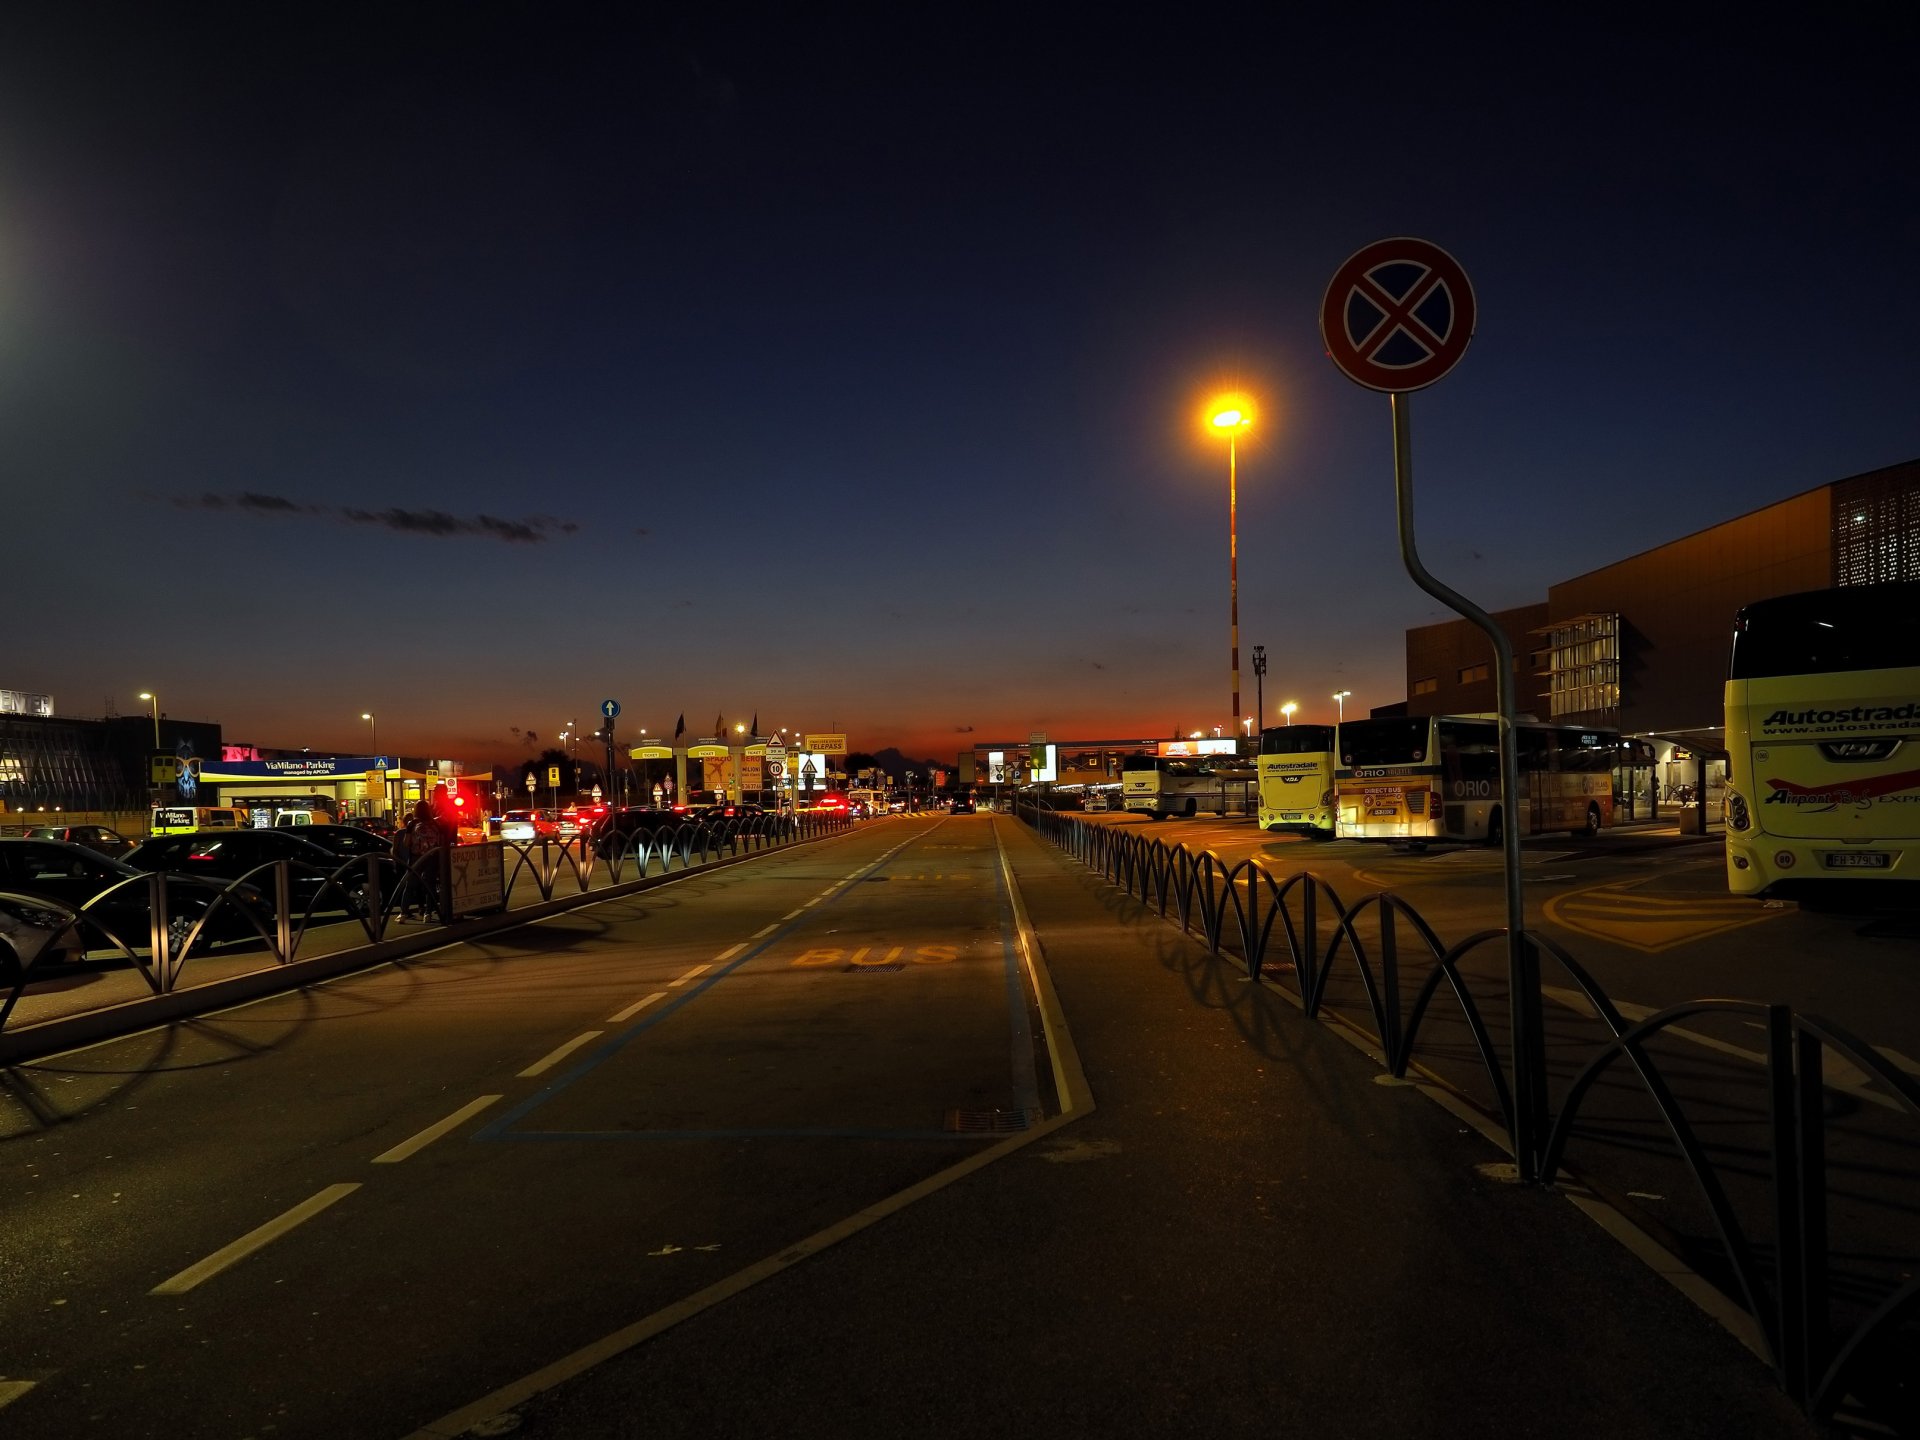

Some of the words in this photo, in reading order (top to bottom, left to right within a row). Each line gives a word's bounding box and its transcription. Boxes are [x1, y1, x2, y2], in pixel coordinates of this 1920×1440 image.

[265, 761, 303, 770] ViaMilano
[306, 761, 336, 771] Parking
[1267, 762, 1318, 770] Autostradale
[1355, 769, 1386, 778] ORIO
[1454, 779, 1490, 797] ORIO
[1764, 787, 1832, 807] Airport
[169, 818, 190, 826] Parking
[1779, 855, 1790, 864] 80
[1833, 855, 1847, 865] FH
[790, 945, 960, 966] BUS
